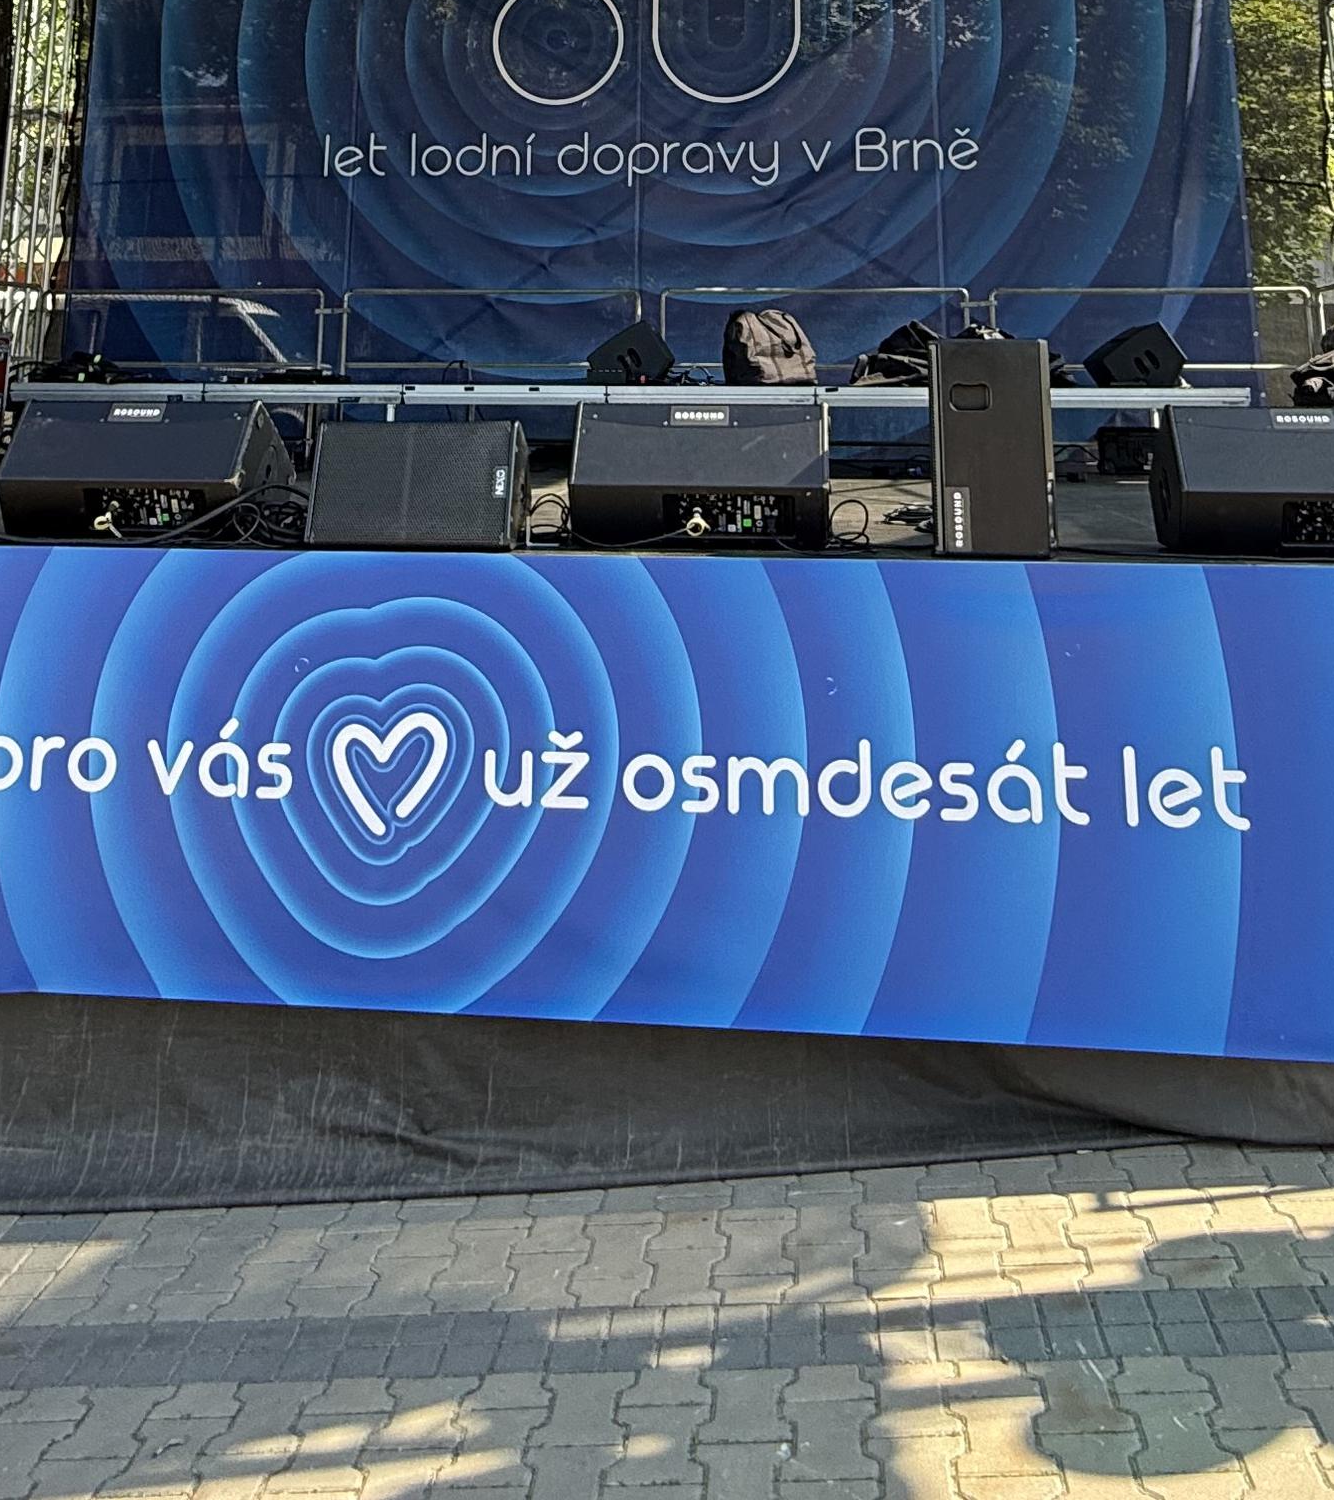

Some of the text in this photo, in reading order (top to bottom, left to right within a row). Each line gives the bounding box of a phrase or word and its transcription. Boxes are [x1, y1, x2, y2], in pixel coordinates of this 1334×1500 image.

[322, 126, 980, 188] let lodní dopravy v Brně
[494, 469, 506, 496] NEXO
[147, 717, 294, 800] vás
[484, 730, 591, 809] už
[622, 739, 1090, 826] osmdesát
[1122, 746, 1251, 831] let
